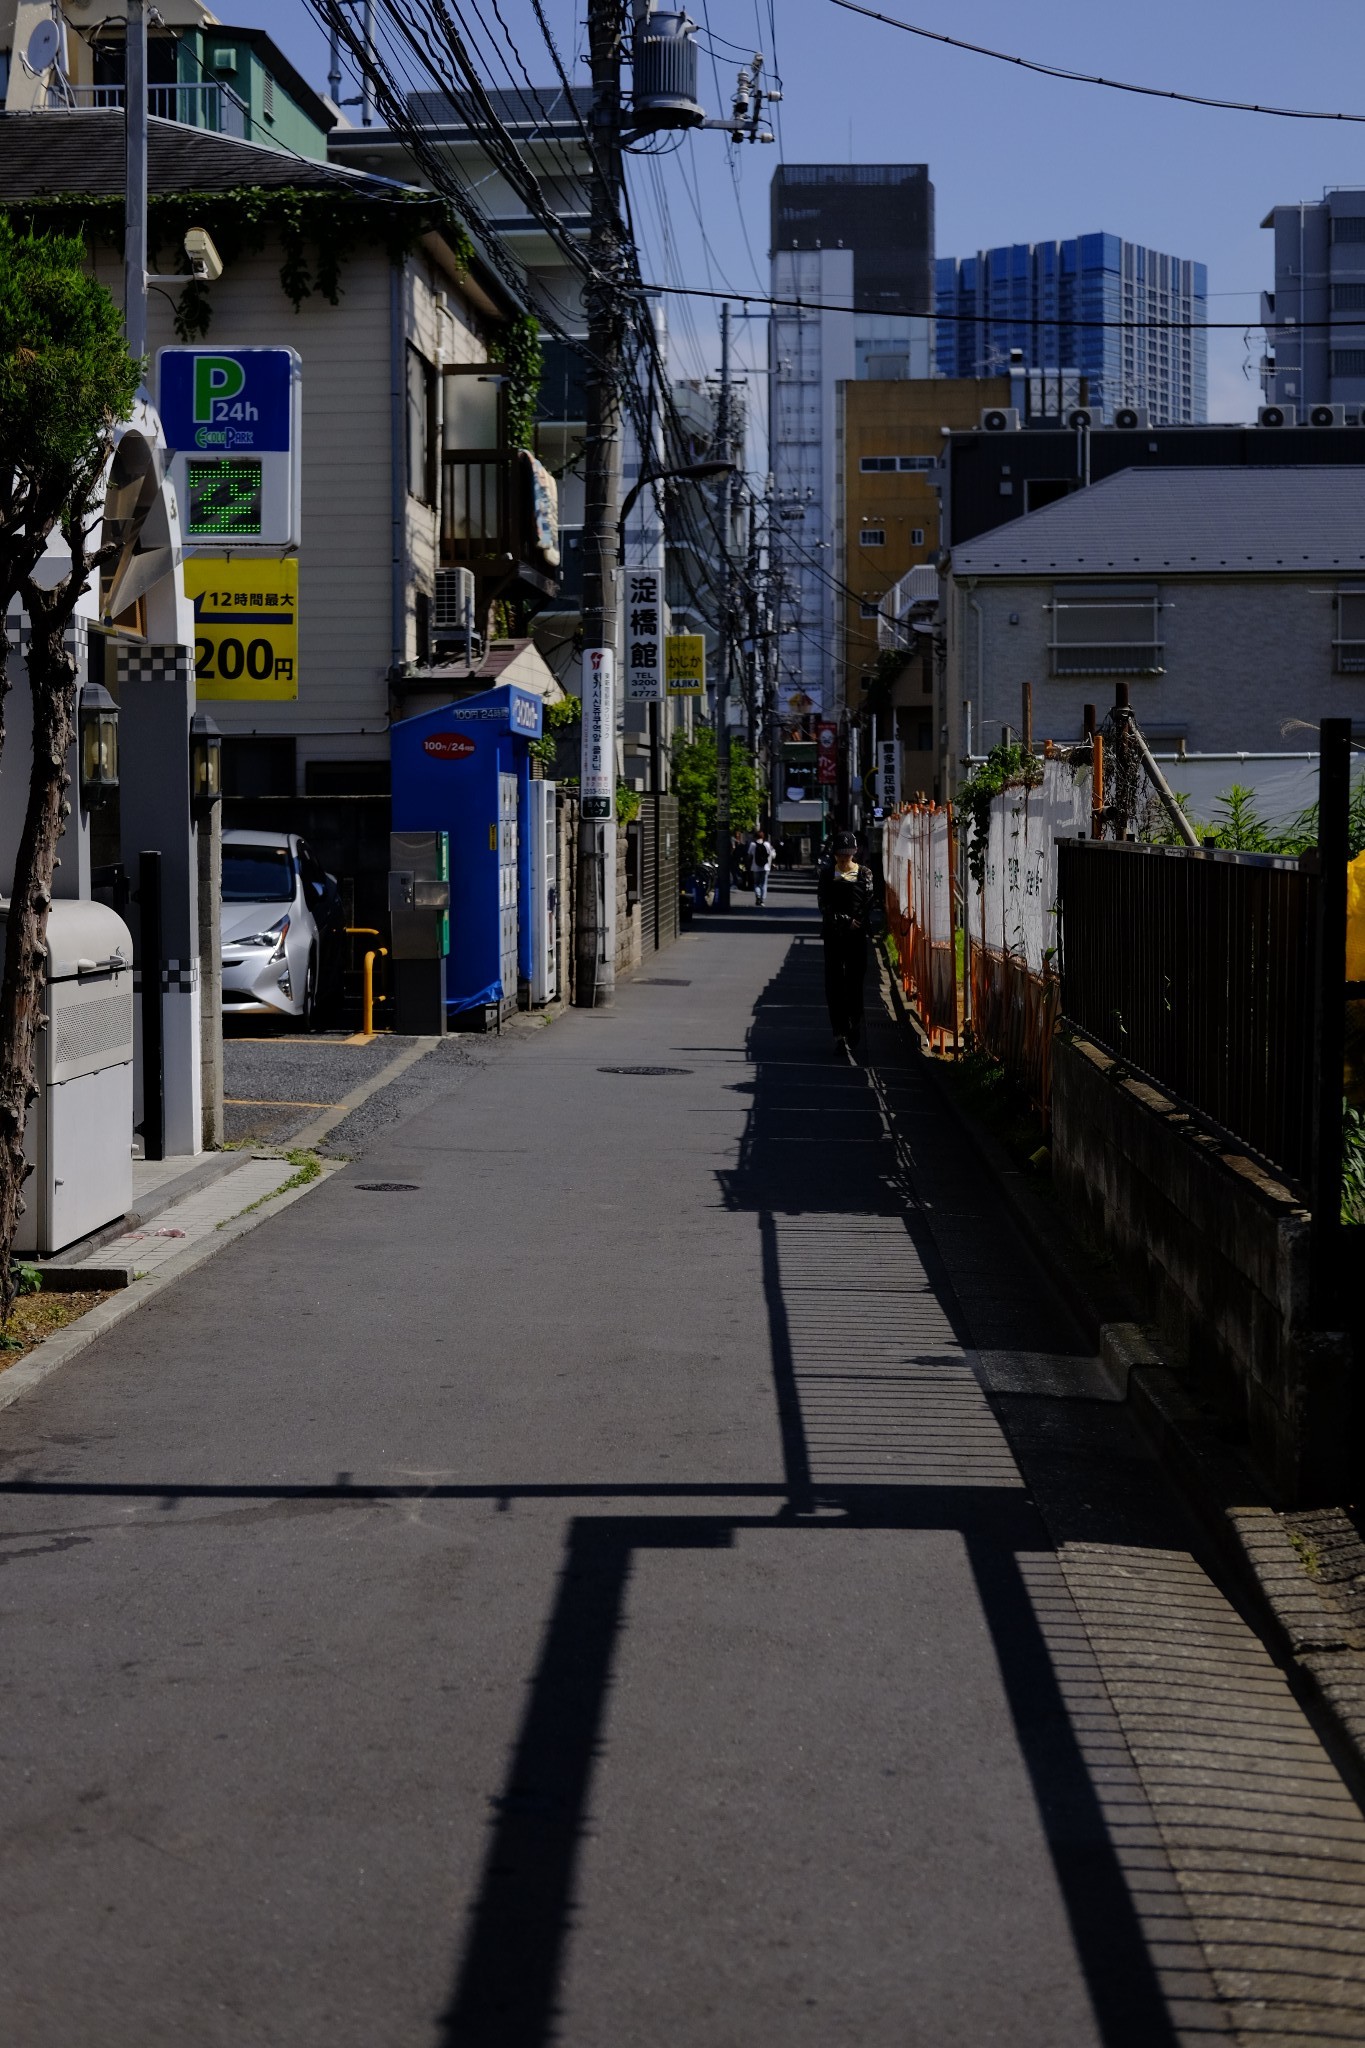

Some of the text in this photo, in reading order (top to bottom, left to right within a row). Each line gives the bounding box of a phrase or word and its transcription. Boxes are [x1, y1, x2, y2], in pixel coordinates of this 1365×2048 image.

[193, 355, 246, 424] P
[215, 402, 259, 422] 24h
[189, 460, 261, 533] 空
[209, 591, 294, 607] 12時間最大
[630, 577, 657, 668] 淀橋館
[670, 680, 699, 688] KAJIKA
